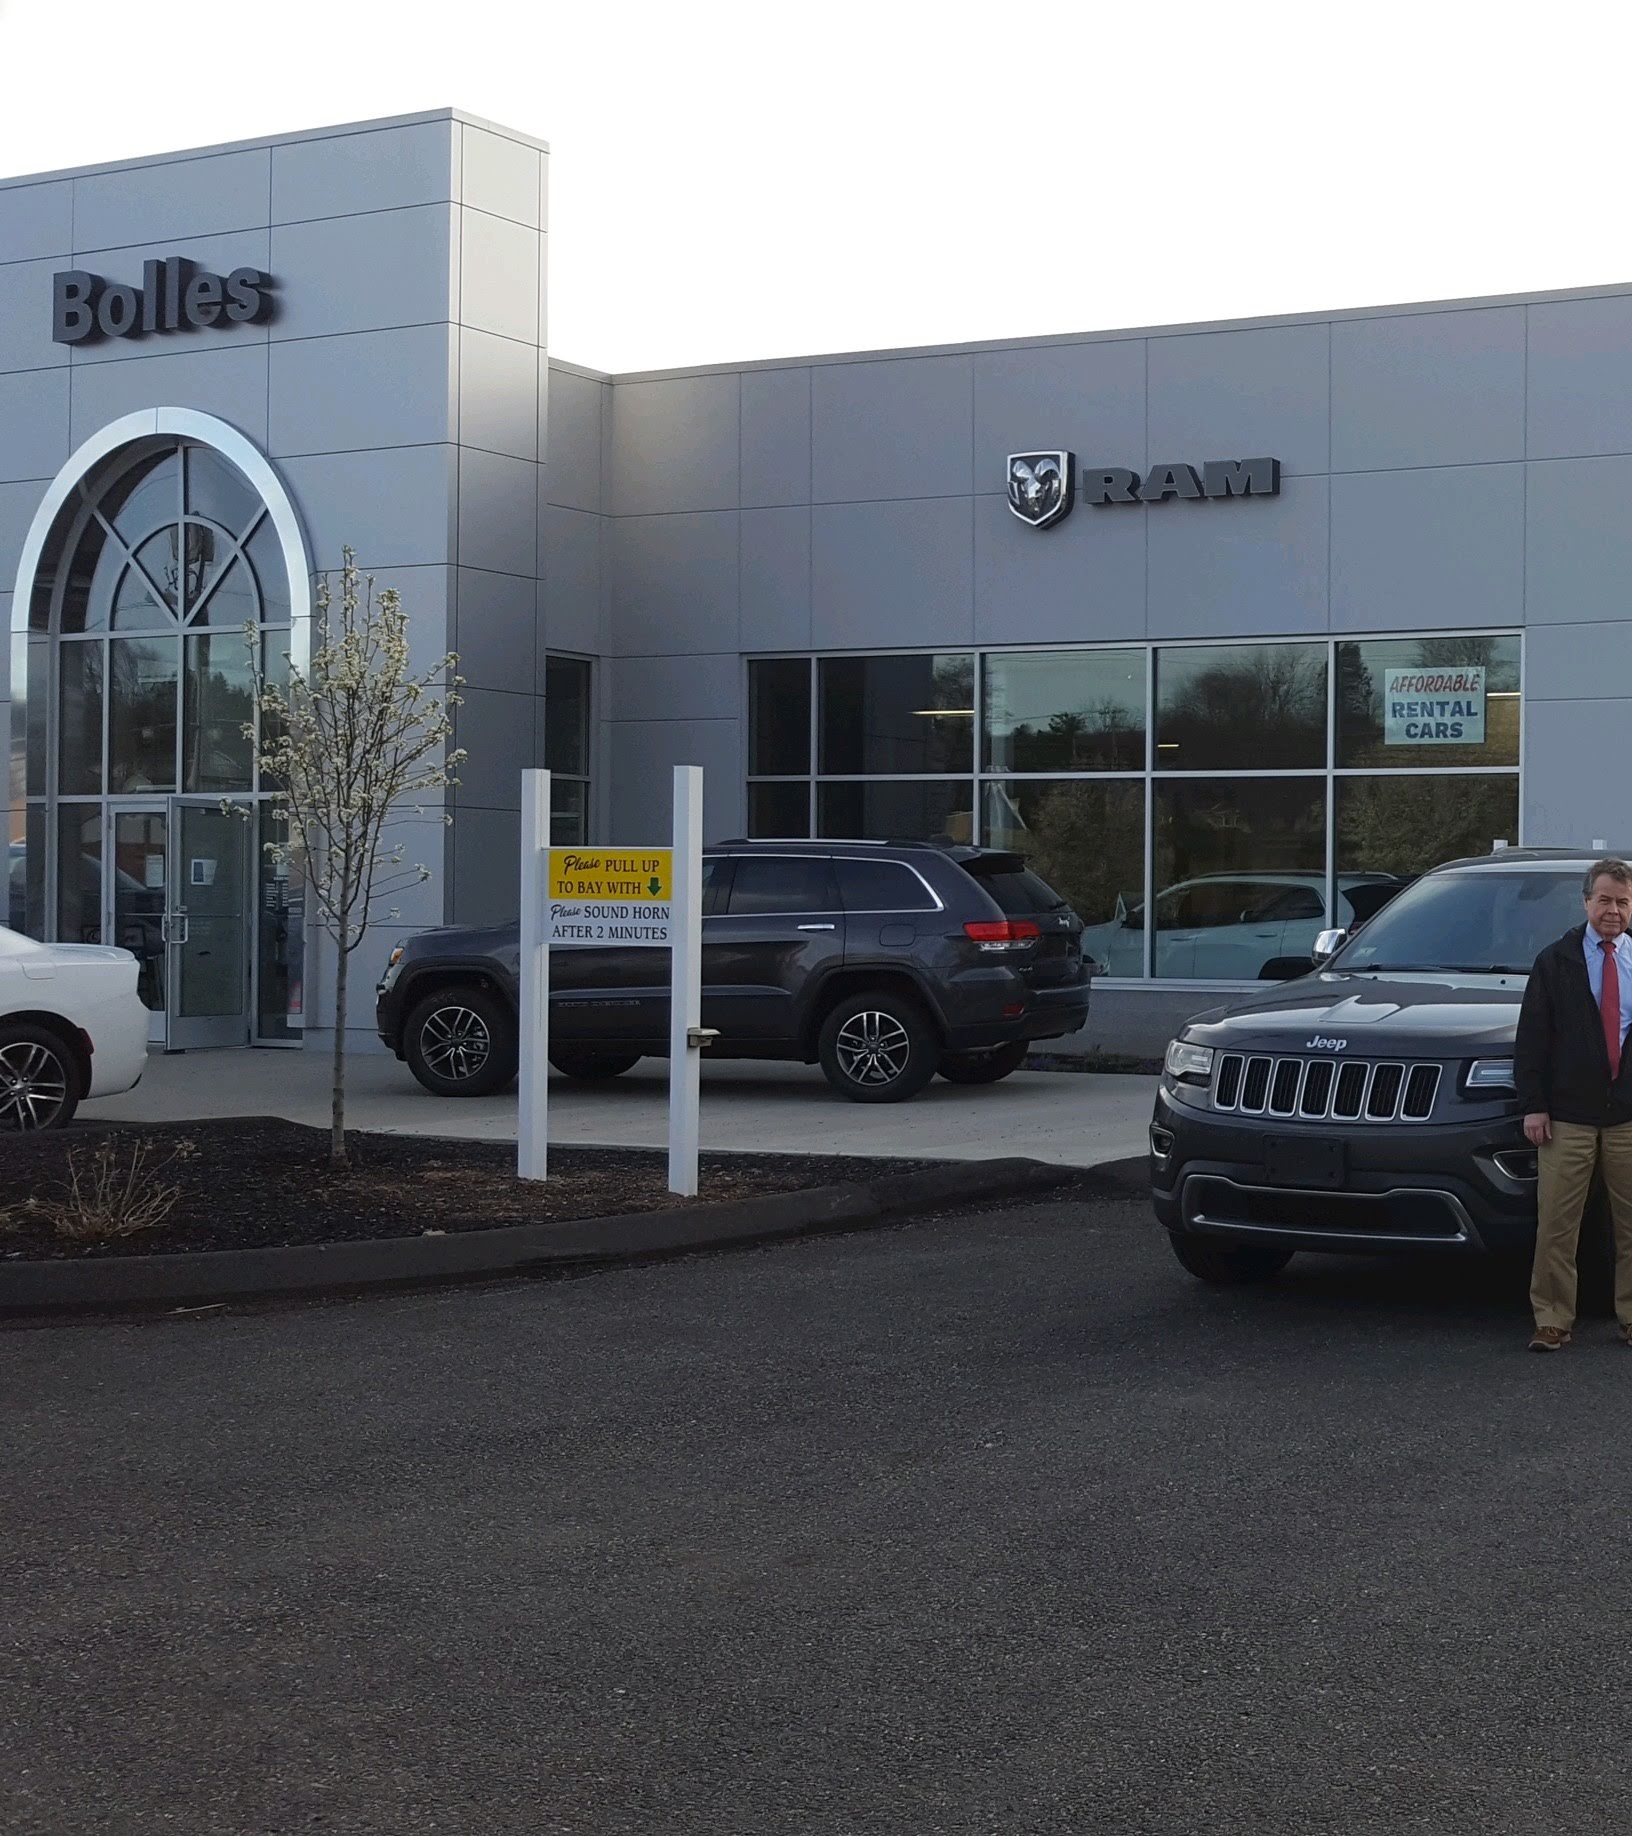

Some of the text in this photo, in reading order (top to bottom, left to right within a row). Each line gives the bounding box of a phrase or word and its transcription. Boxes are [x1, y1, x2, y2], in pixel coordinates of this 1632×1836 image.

[53, 256, 268, 342] Bolles
[1083, 457, 1280, 504] RAM
[1389, 673, 1480, 693] AFFORDABLE
[1392, 701, 1478, 718] RENTAL
[1405, 722, 1463, 739] CARS
[563, 855, 660, 876] Please PULL UP
[557, 881, 641, 895] TO BAY WITH
[550, 904, 670, 921] Please SOUND HORN
[552, 925, 667, 940] AFTER 2 MINUTES
[1306, 1035, 1347, 1052] Jeep
